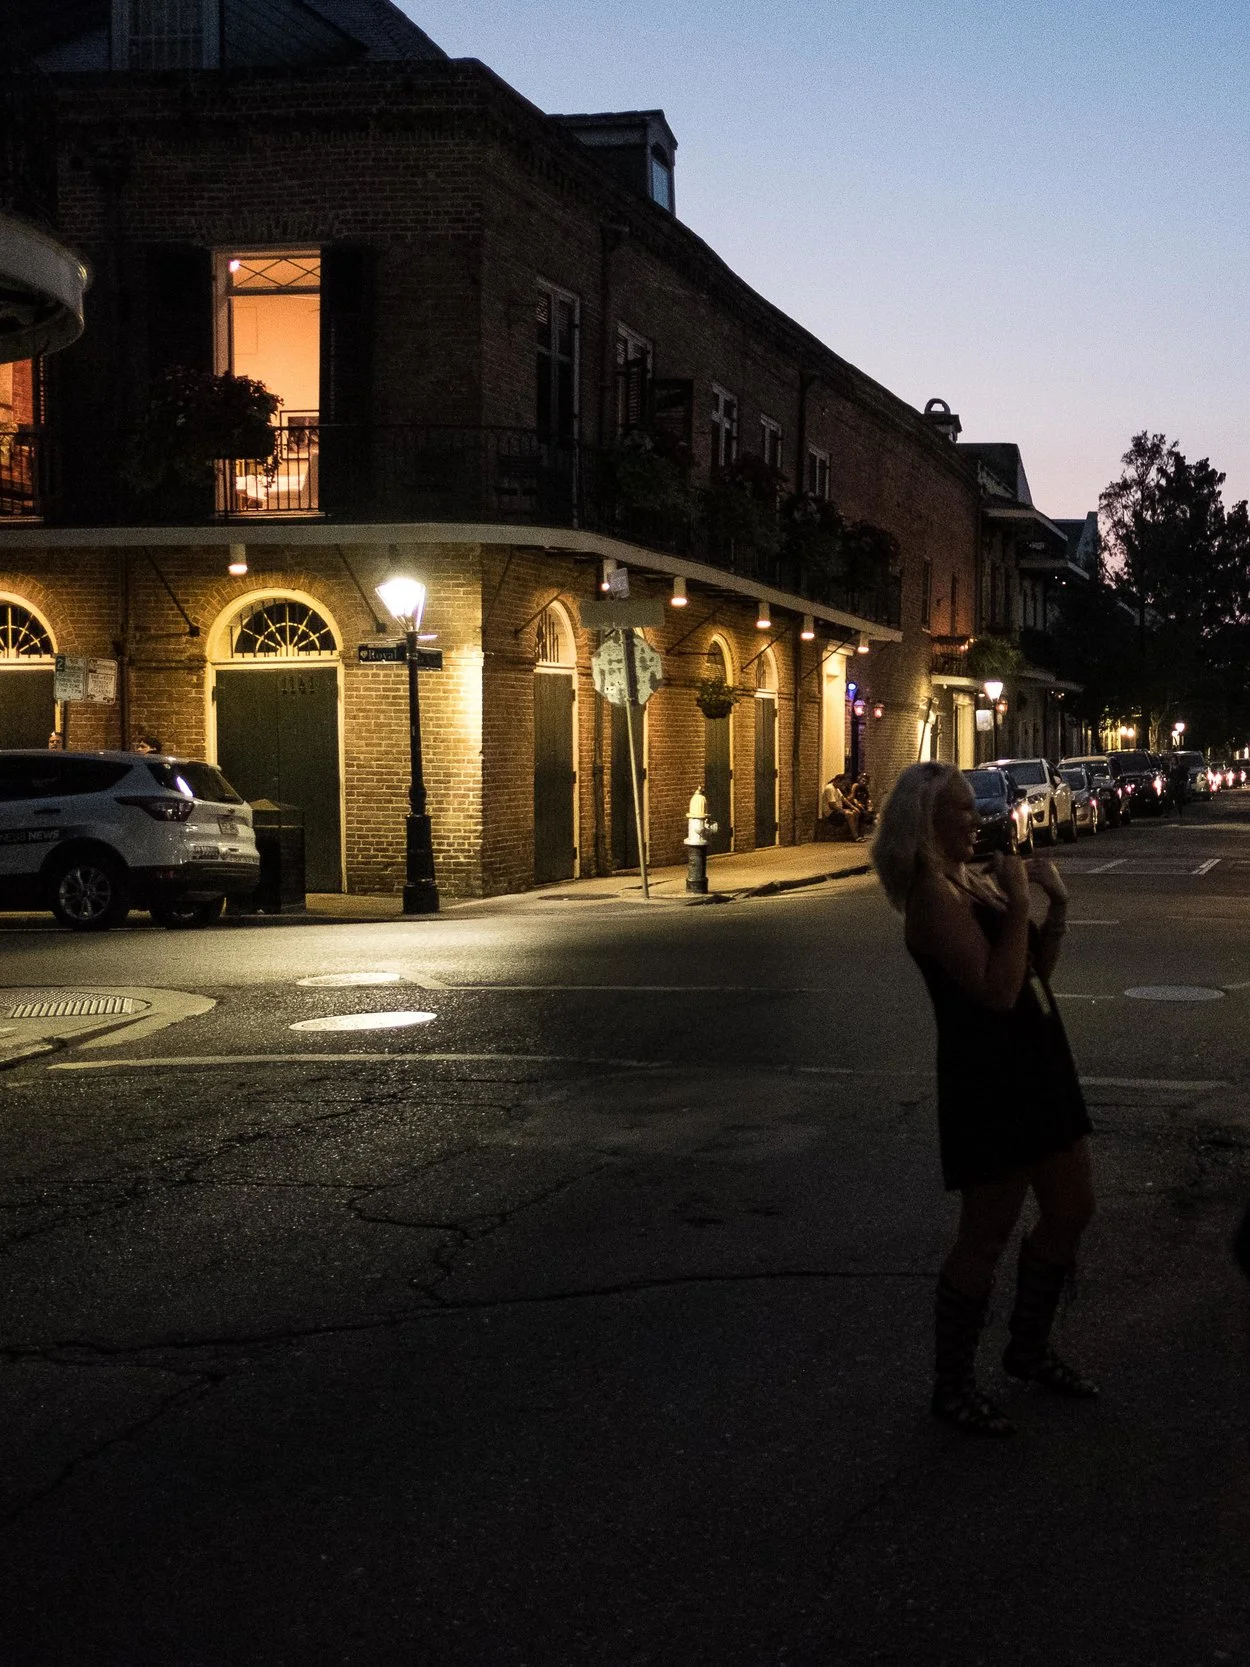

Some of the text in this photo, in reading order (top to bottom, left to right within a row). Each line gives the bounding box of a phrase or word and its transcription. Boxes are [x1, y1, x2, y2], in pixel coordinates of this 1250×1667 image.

[368, 648, 398, 661] Royal
[57, 658, 63, 670] 2
[281, 675, 315, 695] 1141
[28, 829, 60, 842] NEWS
